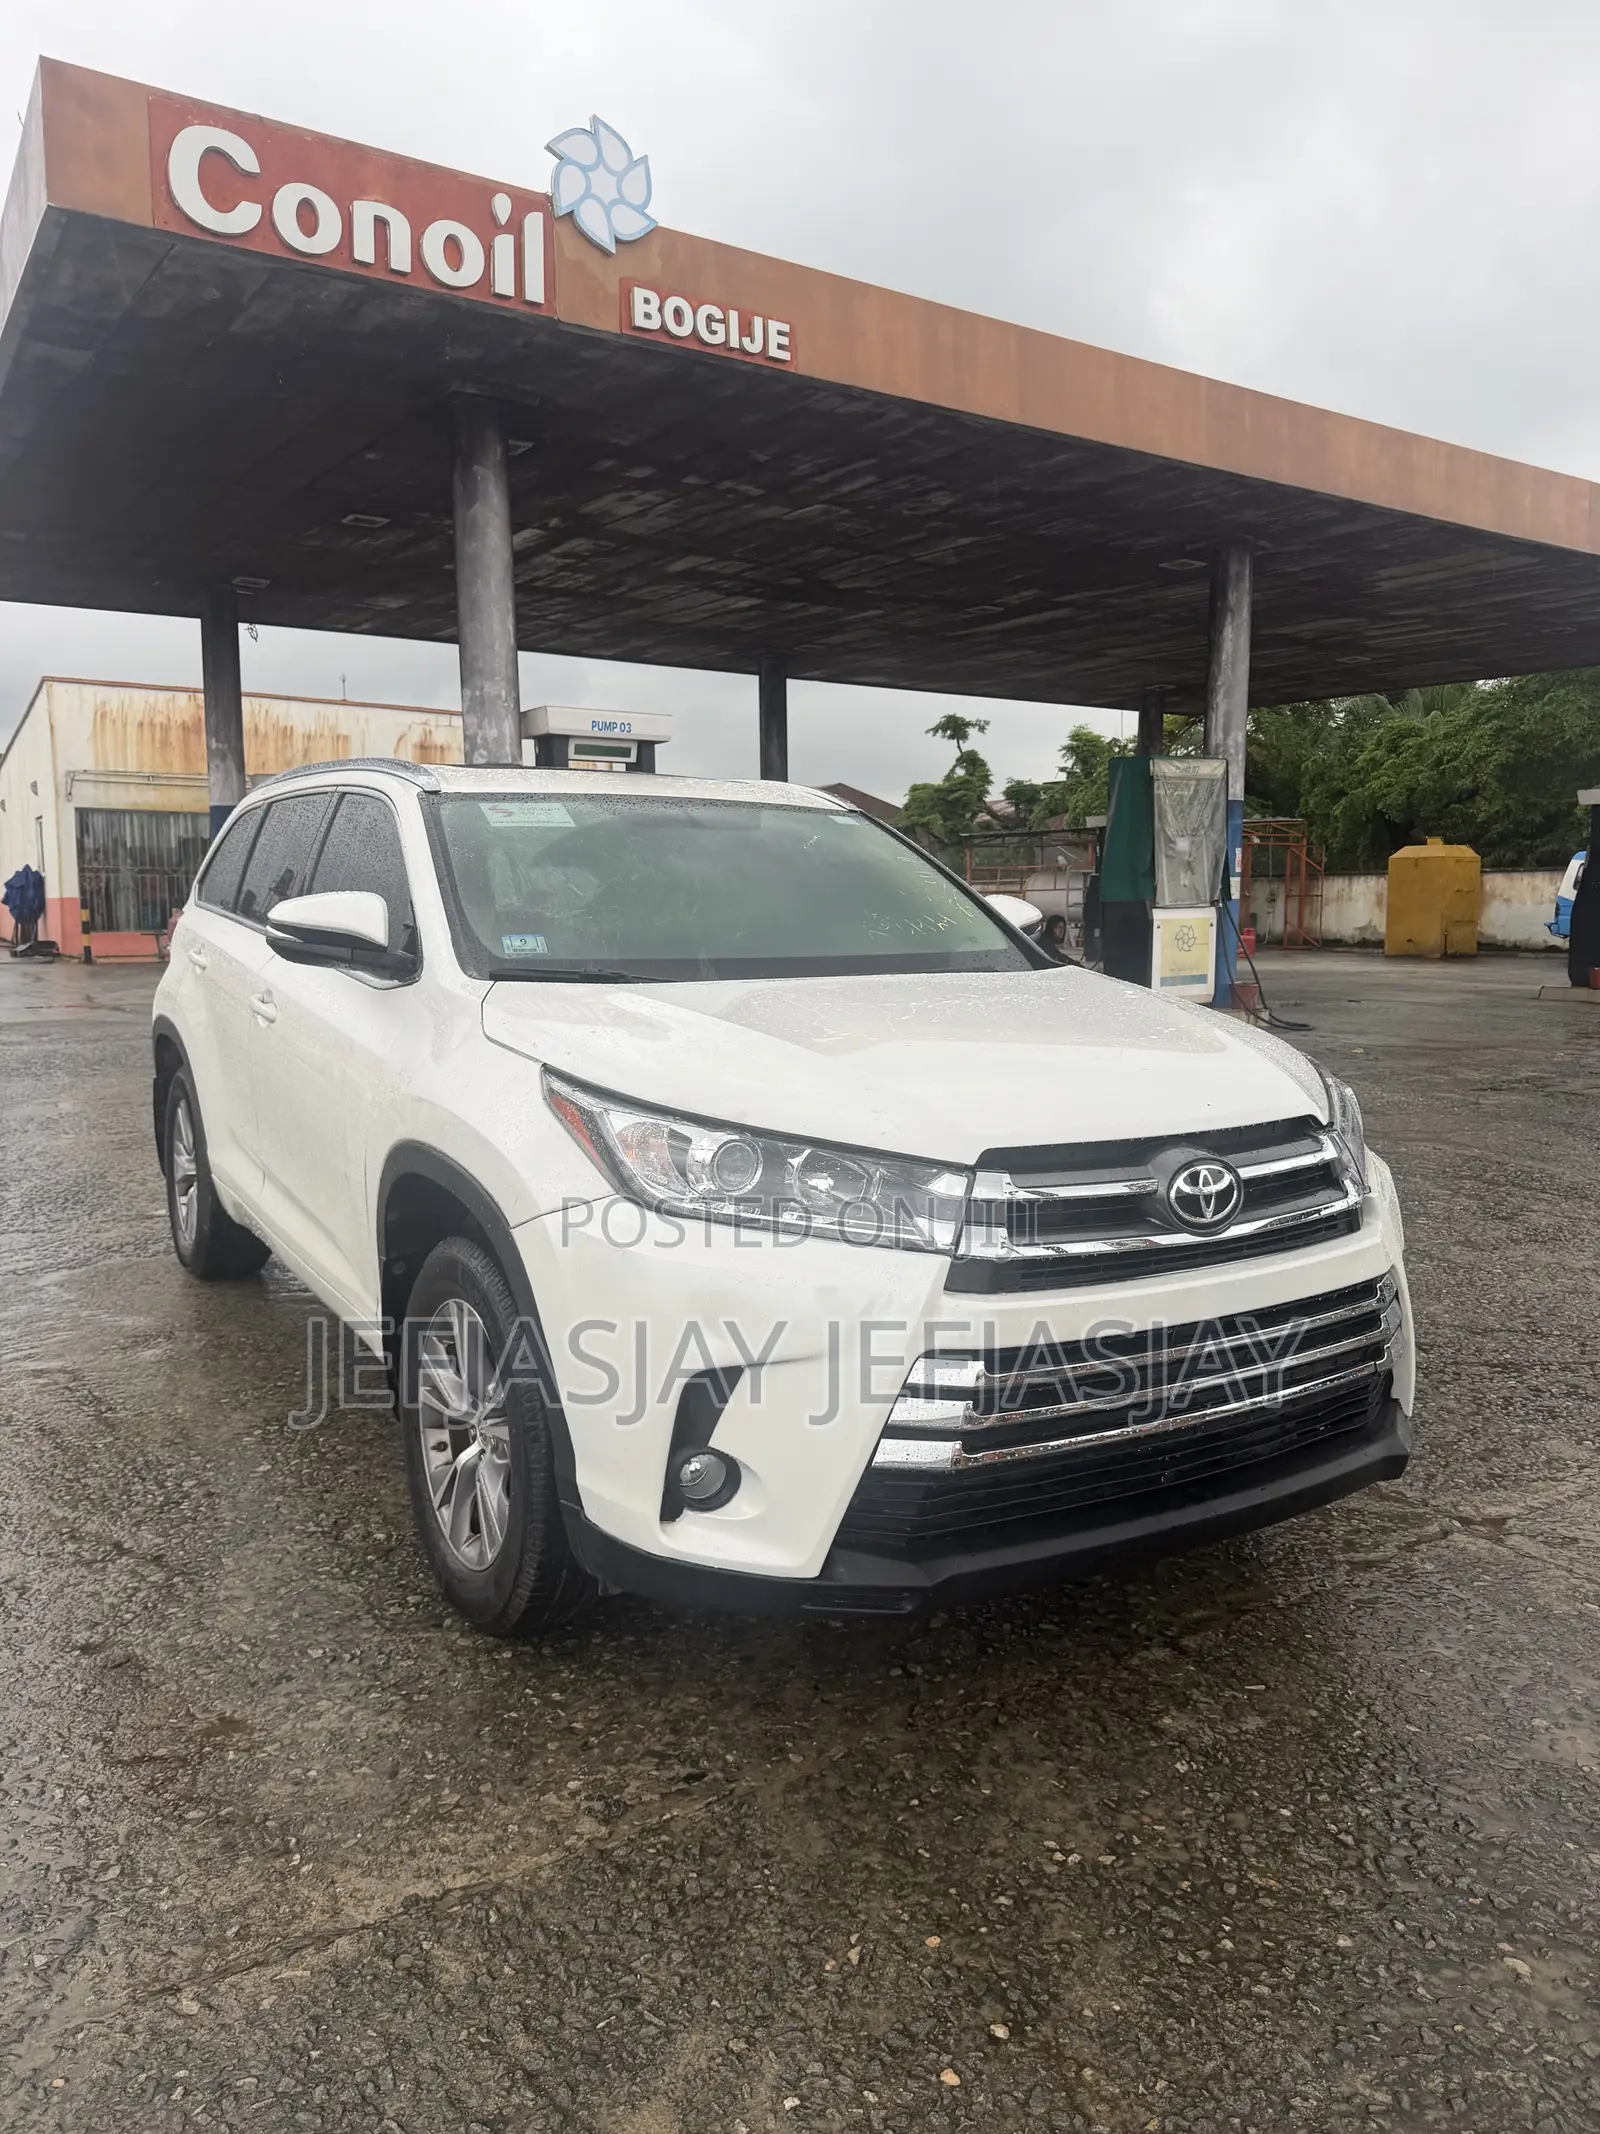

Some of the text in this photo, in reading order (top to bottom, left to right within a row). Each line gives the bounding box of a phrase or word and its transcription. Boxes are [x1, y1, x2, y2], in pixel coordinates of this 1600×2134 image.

[167, 125, 546, 305] Conoil
[630, 286, 792, 363] BOGIJE
[591, 720, 632, 734] PUMP 03
